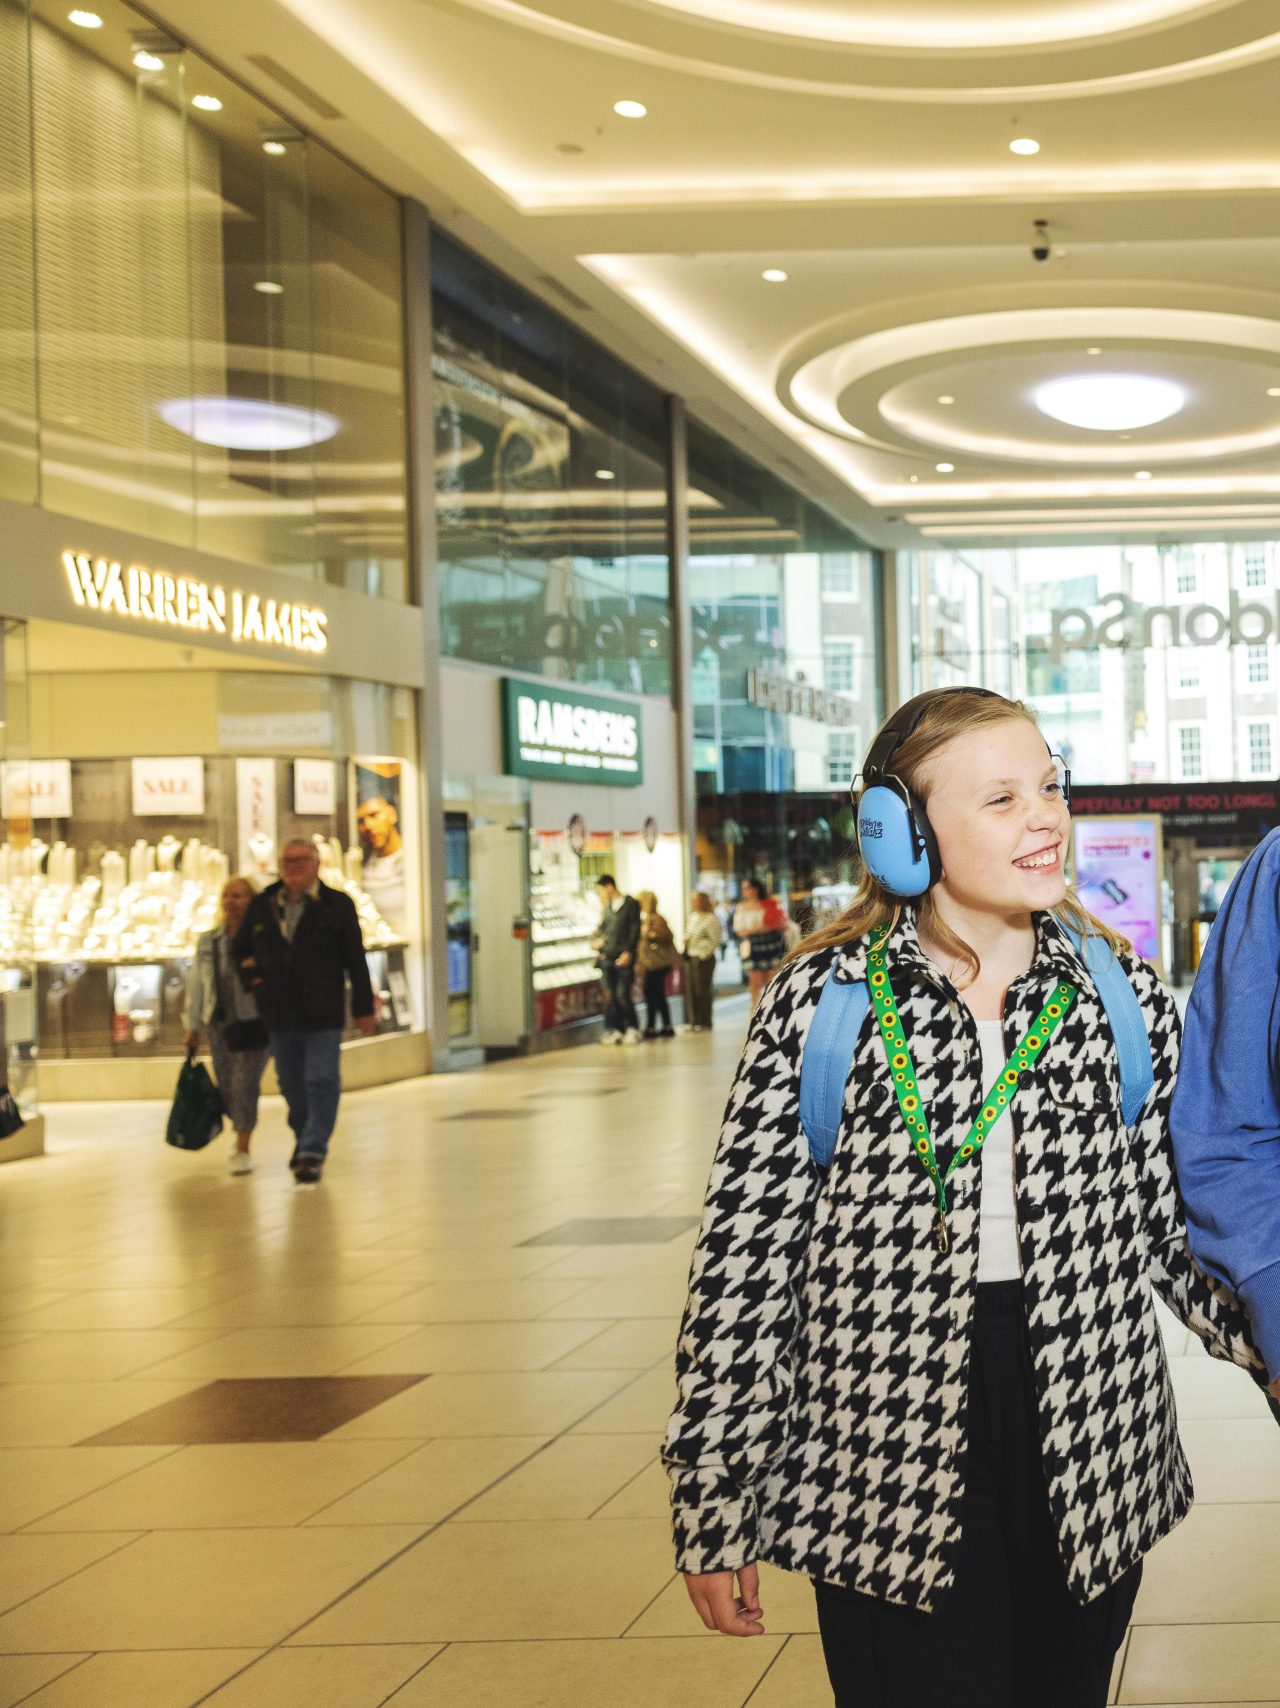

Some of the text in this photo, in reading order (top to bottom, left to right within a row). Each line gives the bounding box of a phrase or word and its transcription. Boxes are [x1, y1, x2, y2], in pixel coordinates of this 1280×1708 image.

[62, 550, 328, 653] WARREN JAMES
[518, 695, 638, 757] RAMSDENS
[143, 778, 195, 796] SALE
[1147, 795, 1181, 811] NOT
[1186, 794, 1220, 810] TOO
